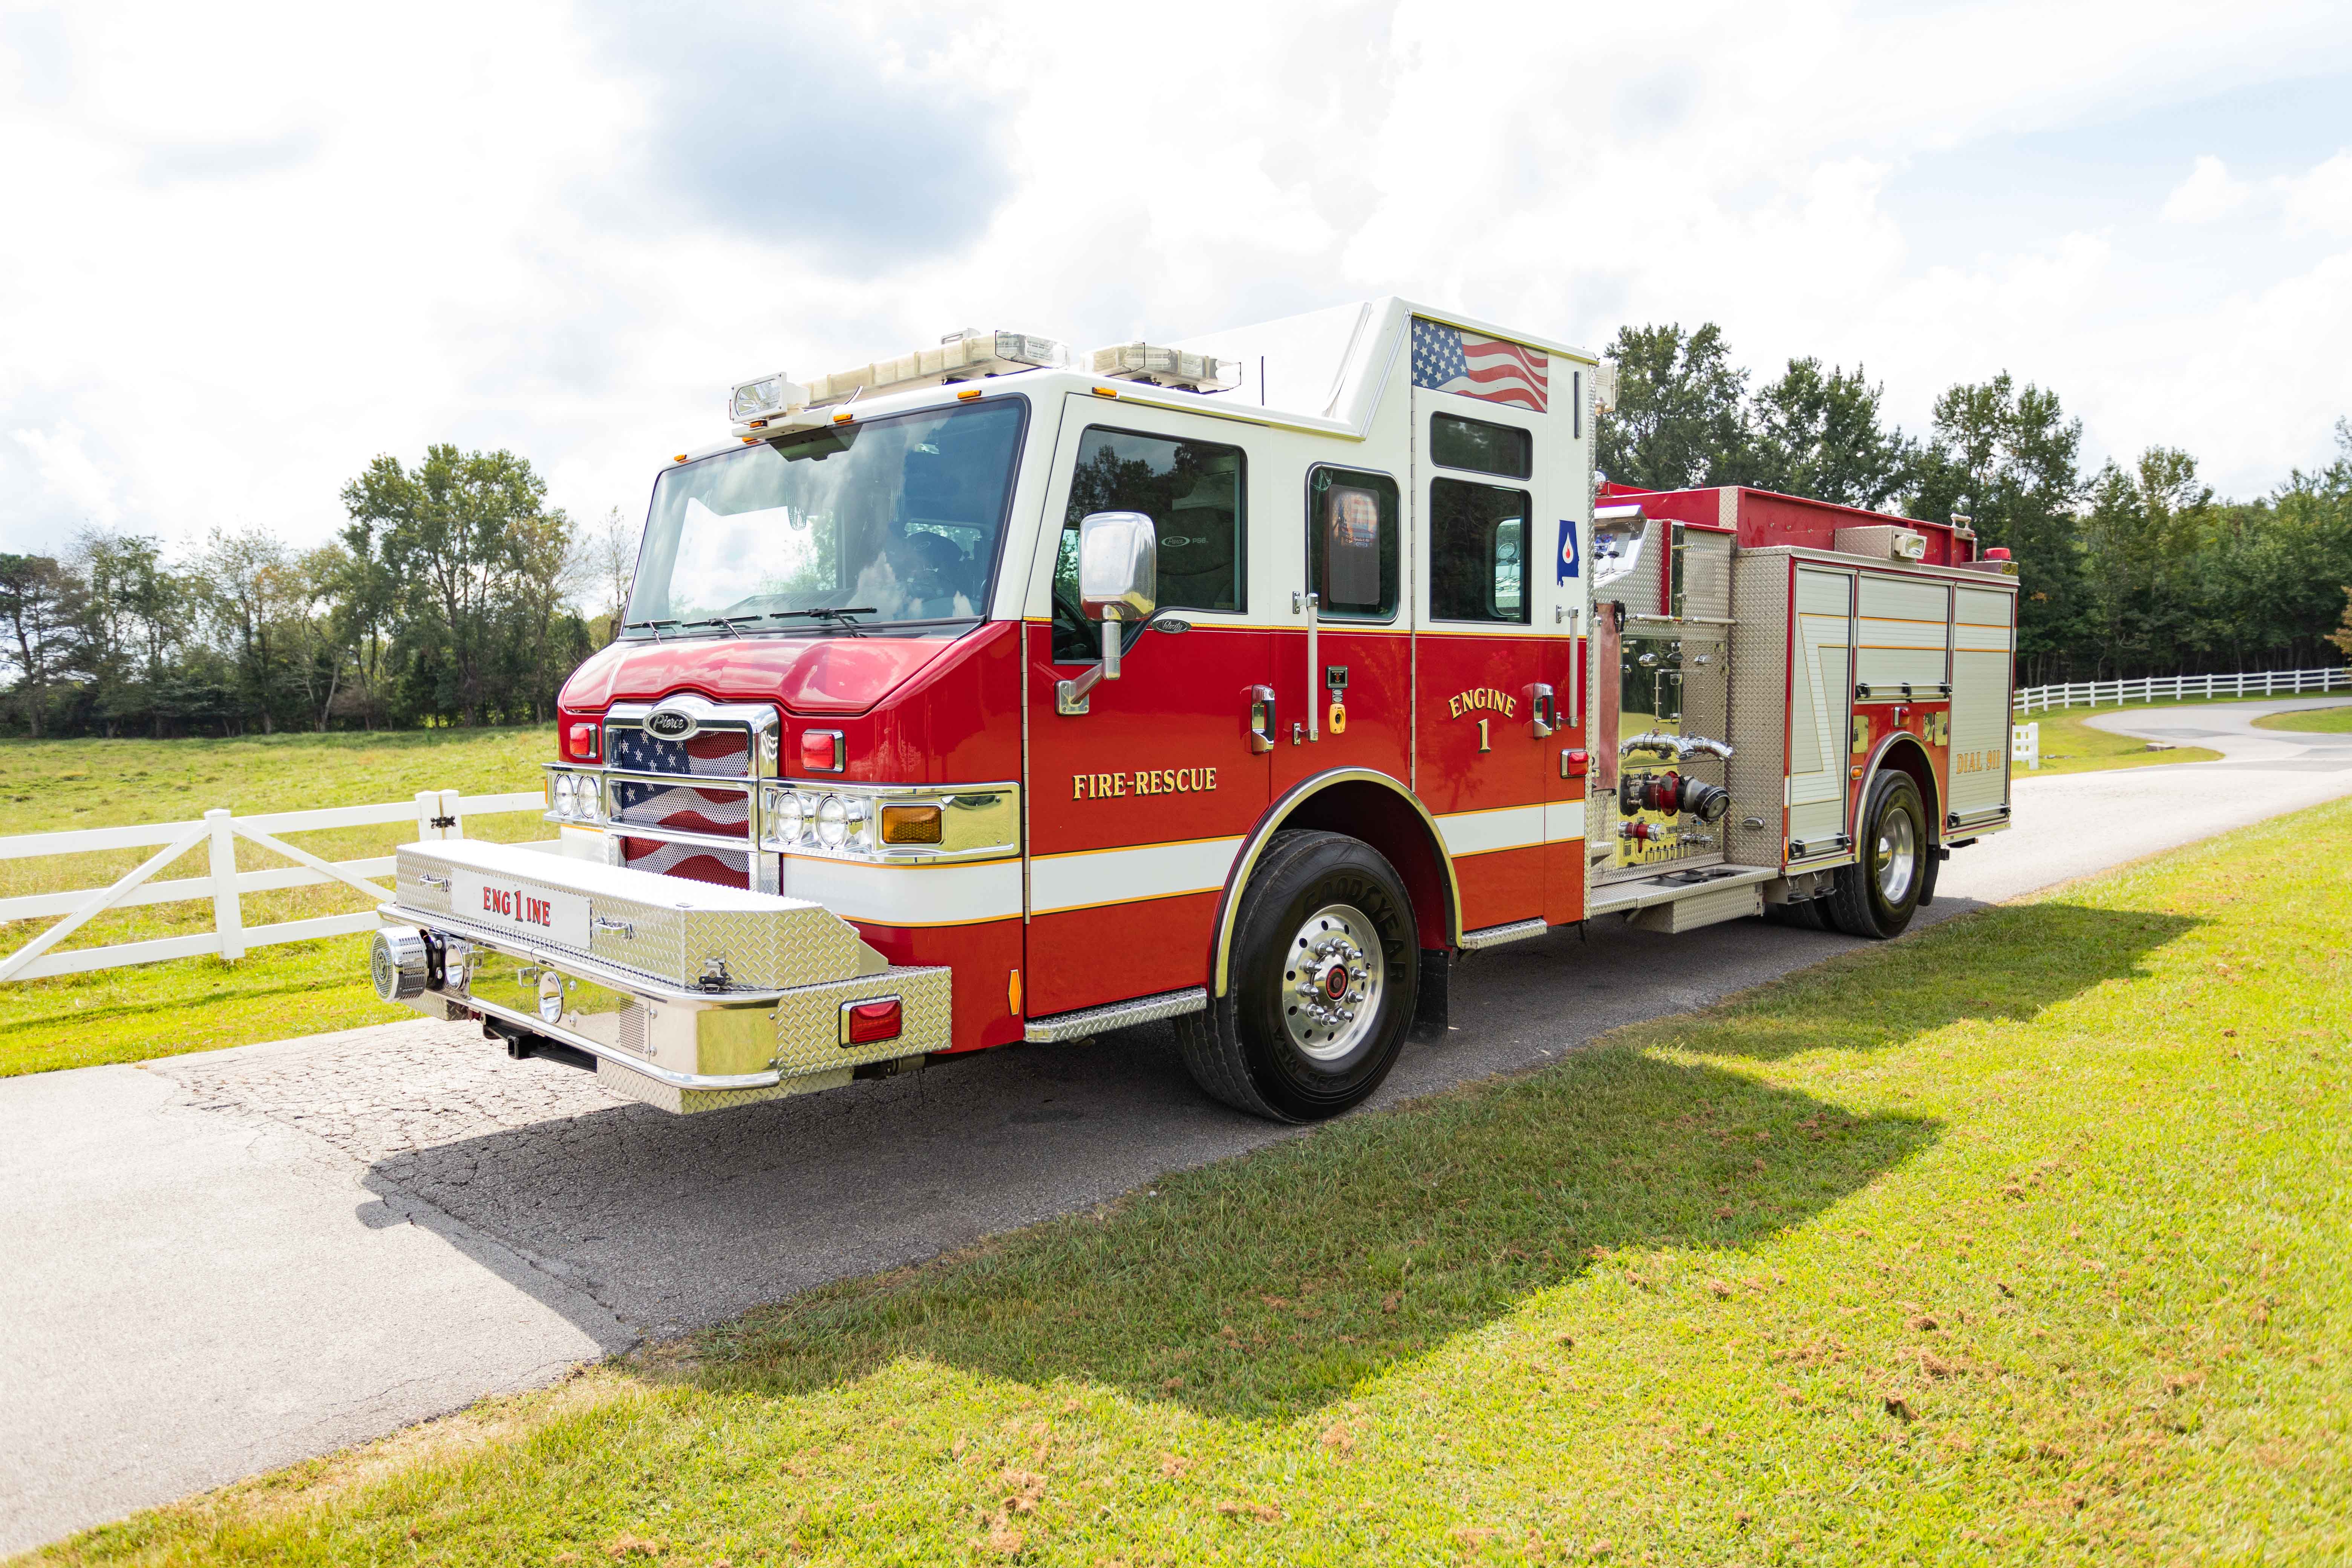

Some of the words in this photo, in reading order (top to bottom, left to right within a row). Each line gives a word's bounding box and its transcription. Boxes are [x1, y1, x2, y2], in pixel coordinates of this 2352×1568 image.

[1161, 620, 1182, 631] Velocity
[1448, 688, 1516, 720] ENGINE
[652, 714, 684, 730] Pierce
[1477, 718, 1491, 754] 1
[1956, 752, 1982, 774] DIAL
[1986, 749, 2000, 770] 911
[1072, 767, 1217, 801] FIRE-RESCUE
